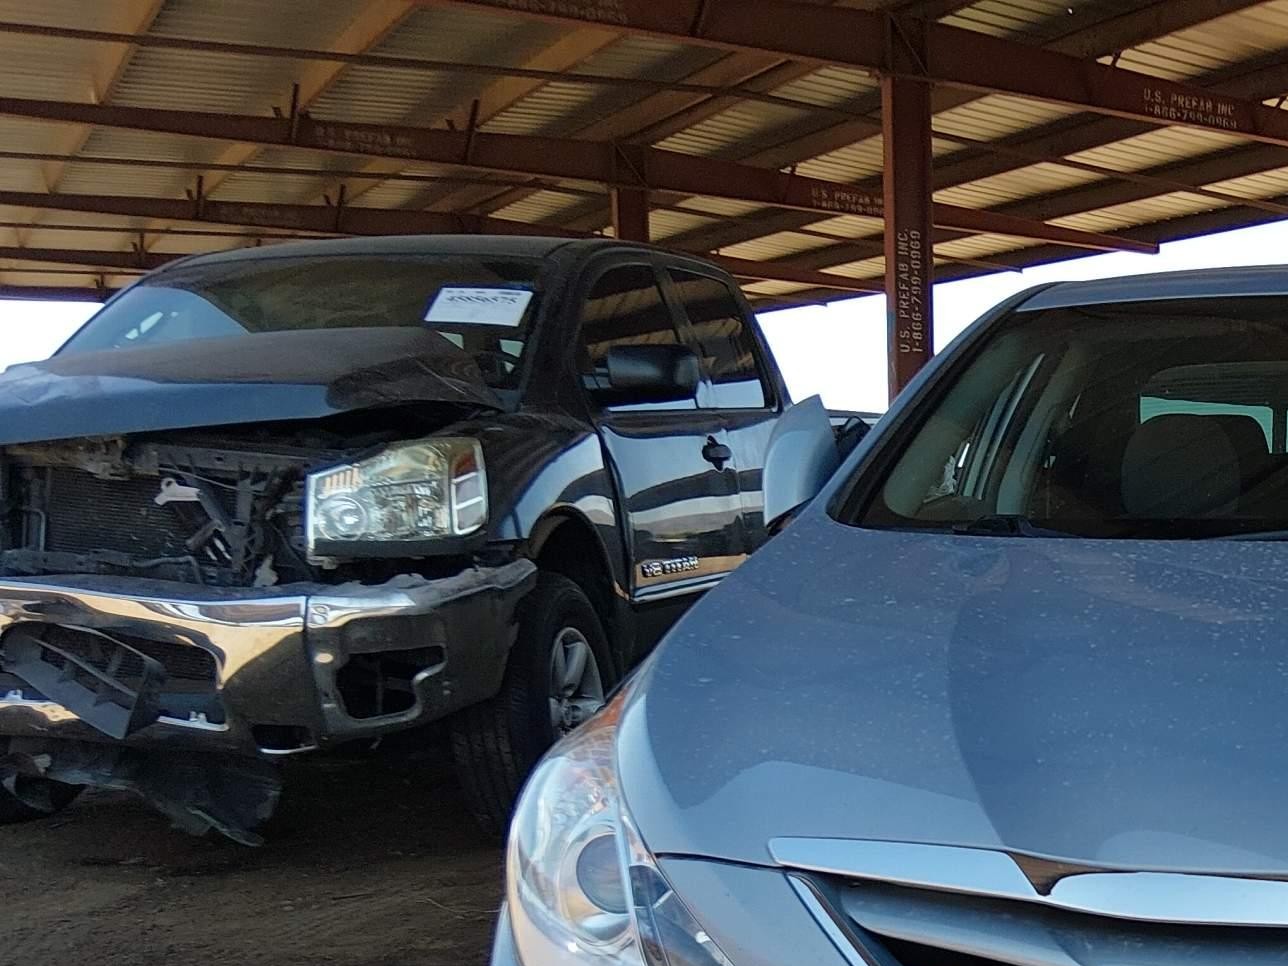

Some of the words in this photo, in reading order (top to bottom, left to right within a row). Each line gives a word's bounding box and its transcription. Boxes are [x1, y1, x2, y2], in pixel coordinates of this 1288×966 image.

[1143, 88, 1165, 105] U.S.
[1170, 92, 1213, 112] PREFAB
[897, 228, 910, 256] INC.
[897, 263, 911, 319] PREFAB
[909, 230, 923, 353] 1-866-799-0969
[899, 326, 912, 353] U.S.
